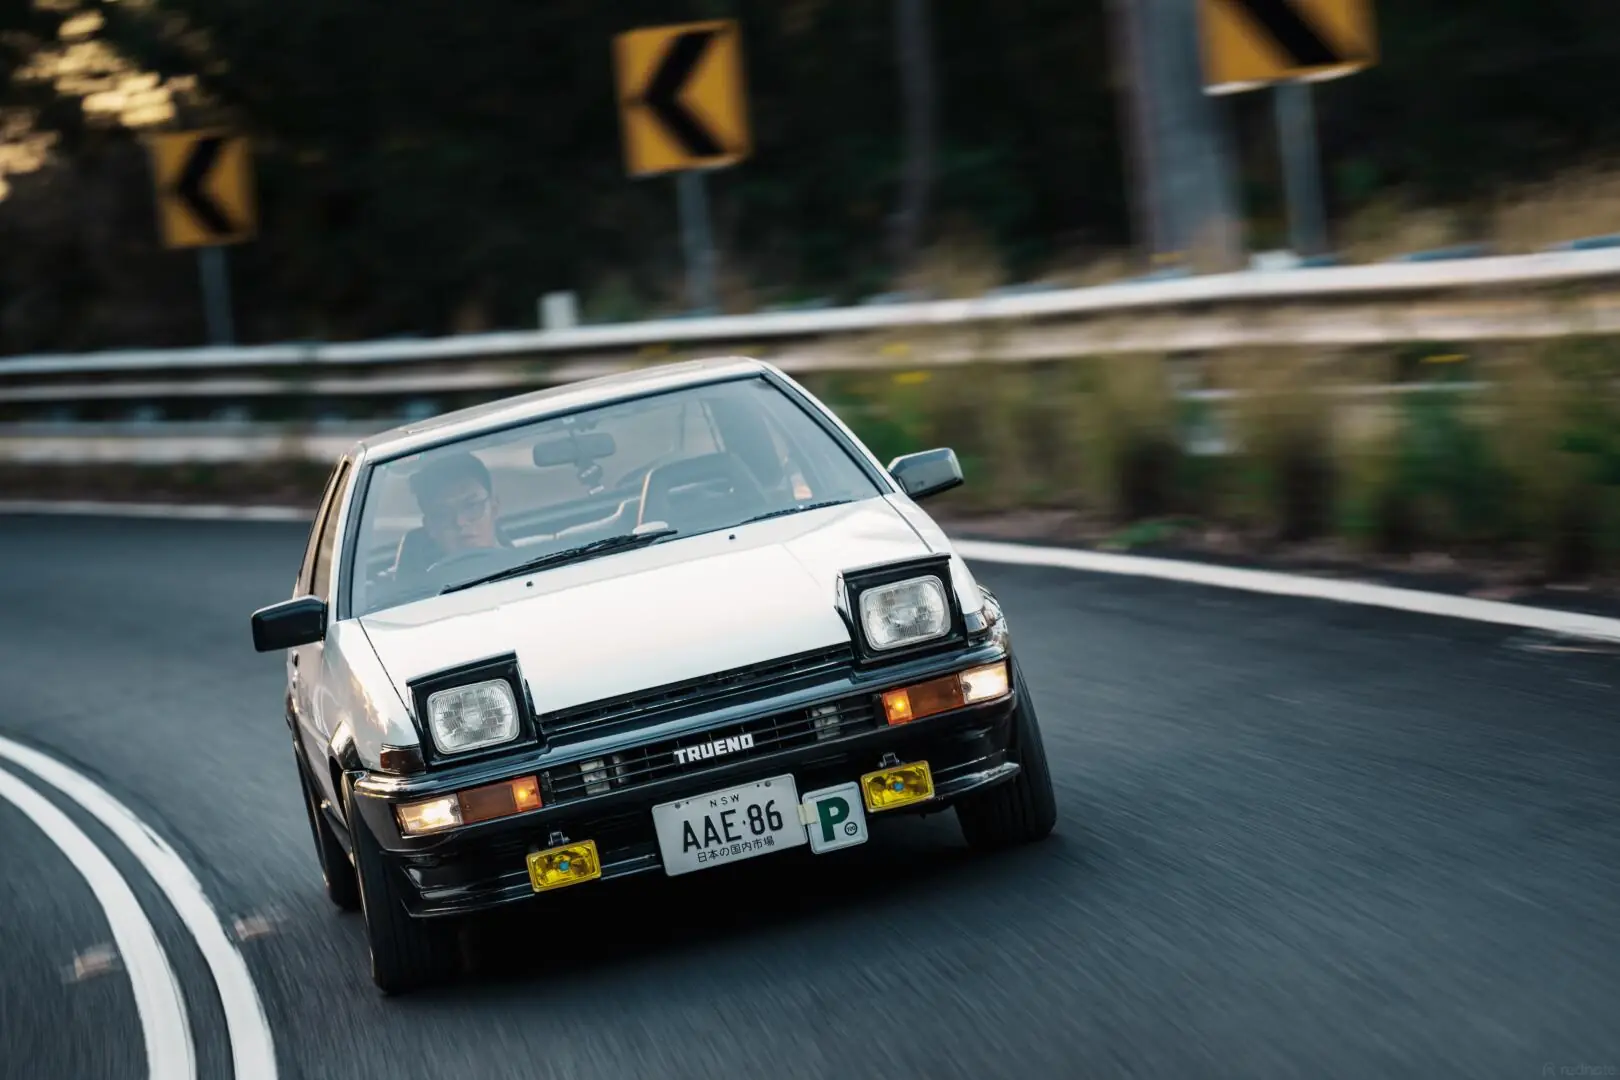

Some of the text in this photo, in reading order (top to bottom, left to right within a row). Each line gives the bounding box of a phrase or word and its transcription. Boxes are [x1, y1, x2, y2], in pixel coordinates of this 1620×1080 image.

[673, 733, 754, 765] TRUENO
[709, 793, 741, 808] NSW
[816, 796, 850, 842] P
[697, 835, 775, 863] 日本の国内市場
